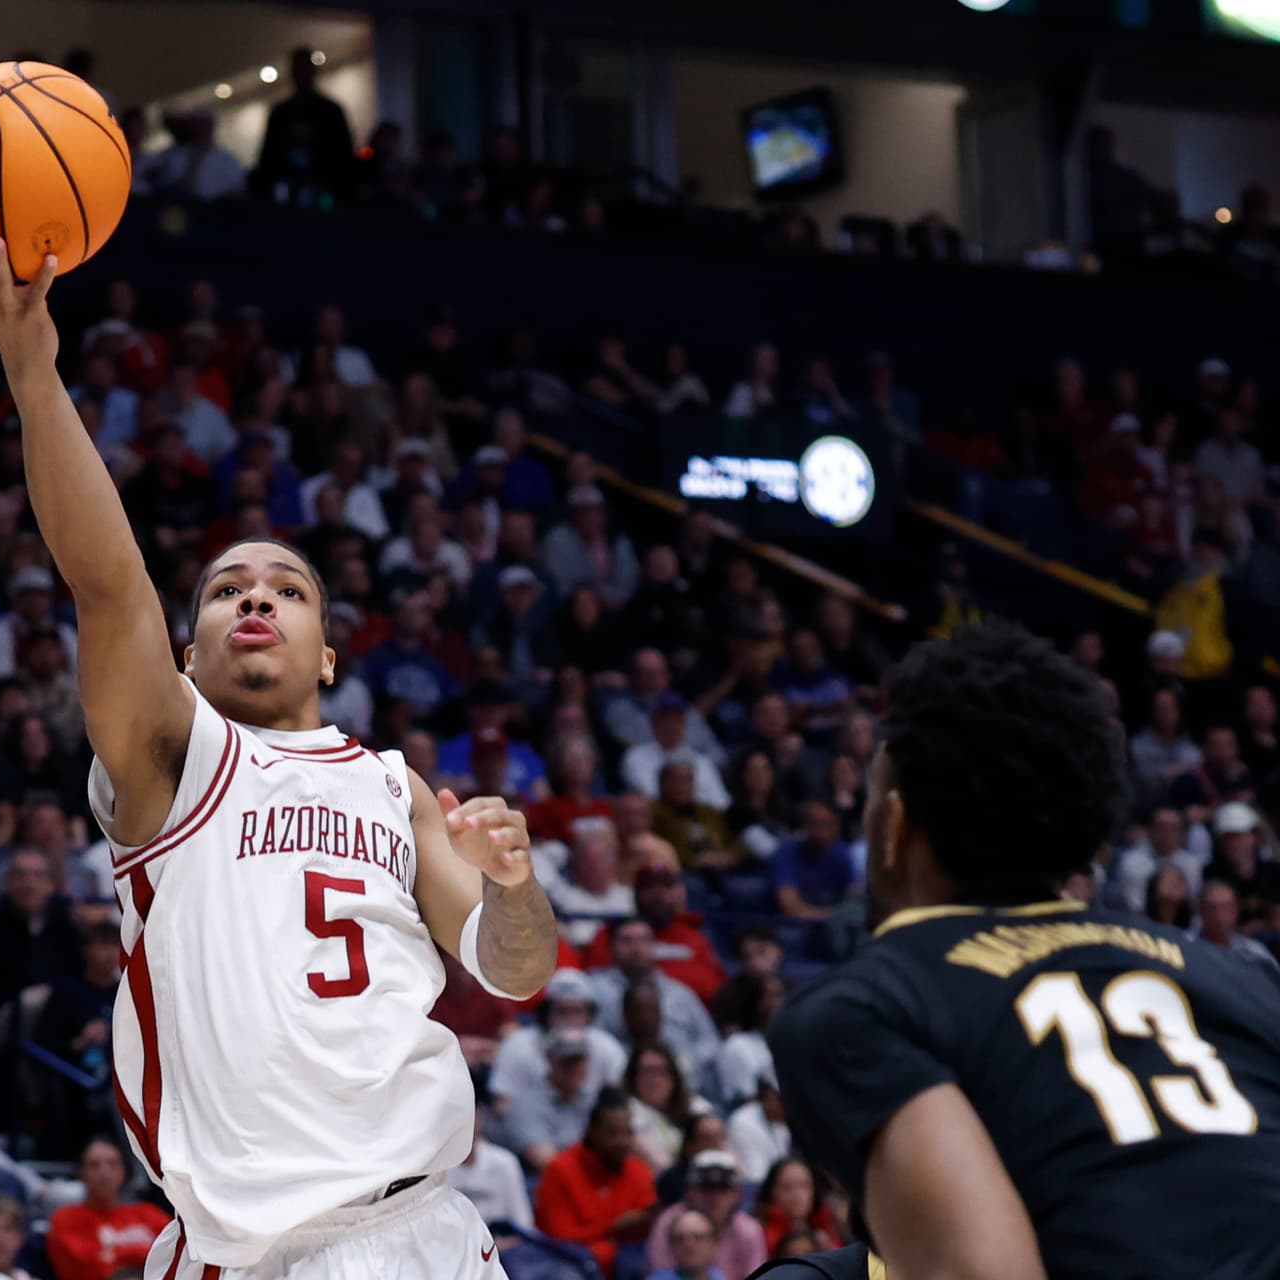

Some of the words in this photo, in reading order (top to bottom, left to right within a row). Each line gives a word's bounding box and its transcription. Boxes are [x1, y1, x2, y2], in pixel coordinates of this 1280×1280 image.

[236, 805, 410, 895] RAZORBACKS
[303, 869, 371, 1000] 5
[1014, 969, 1259, 1146] 13
